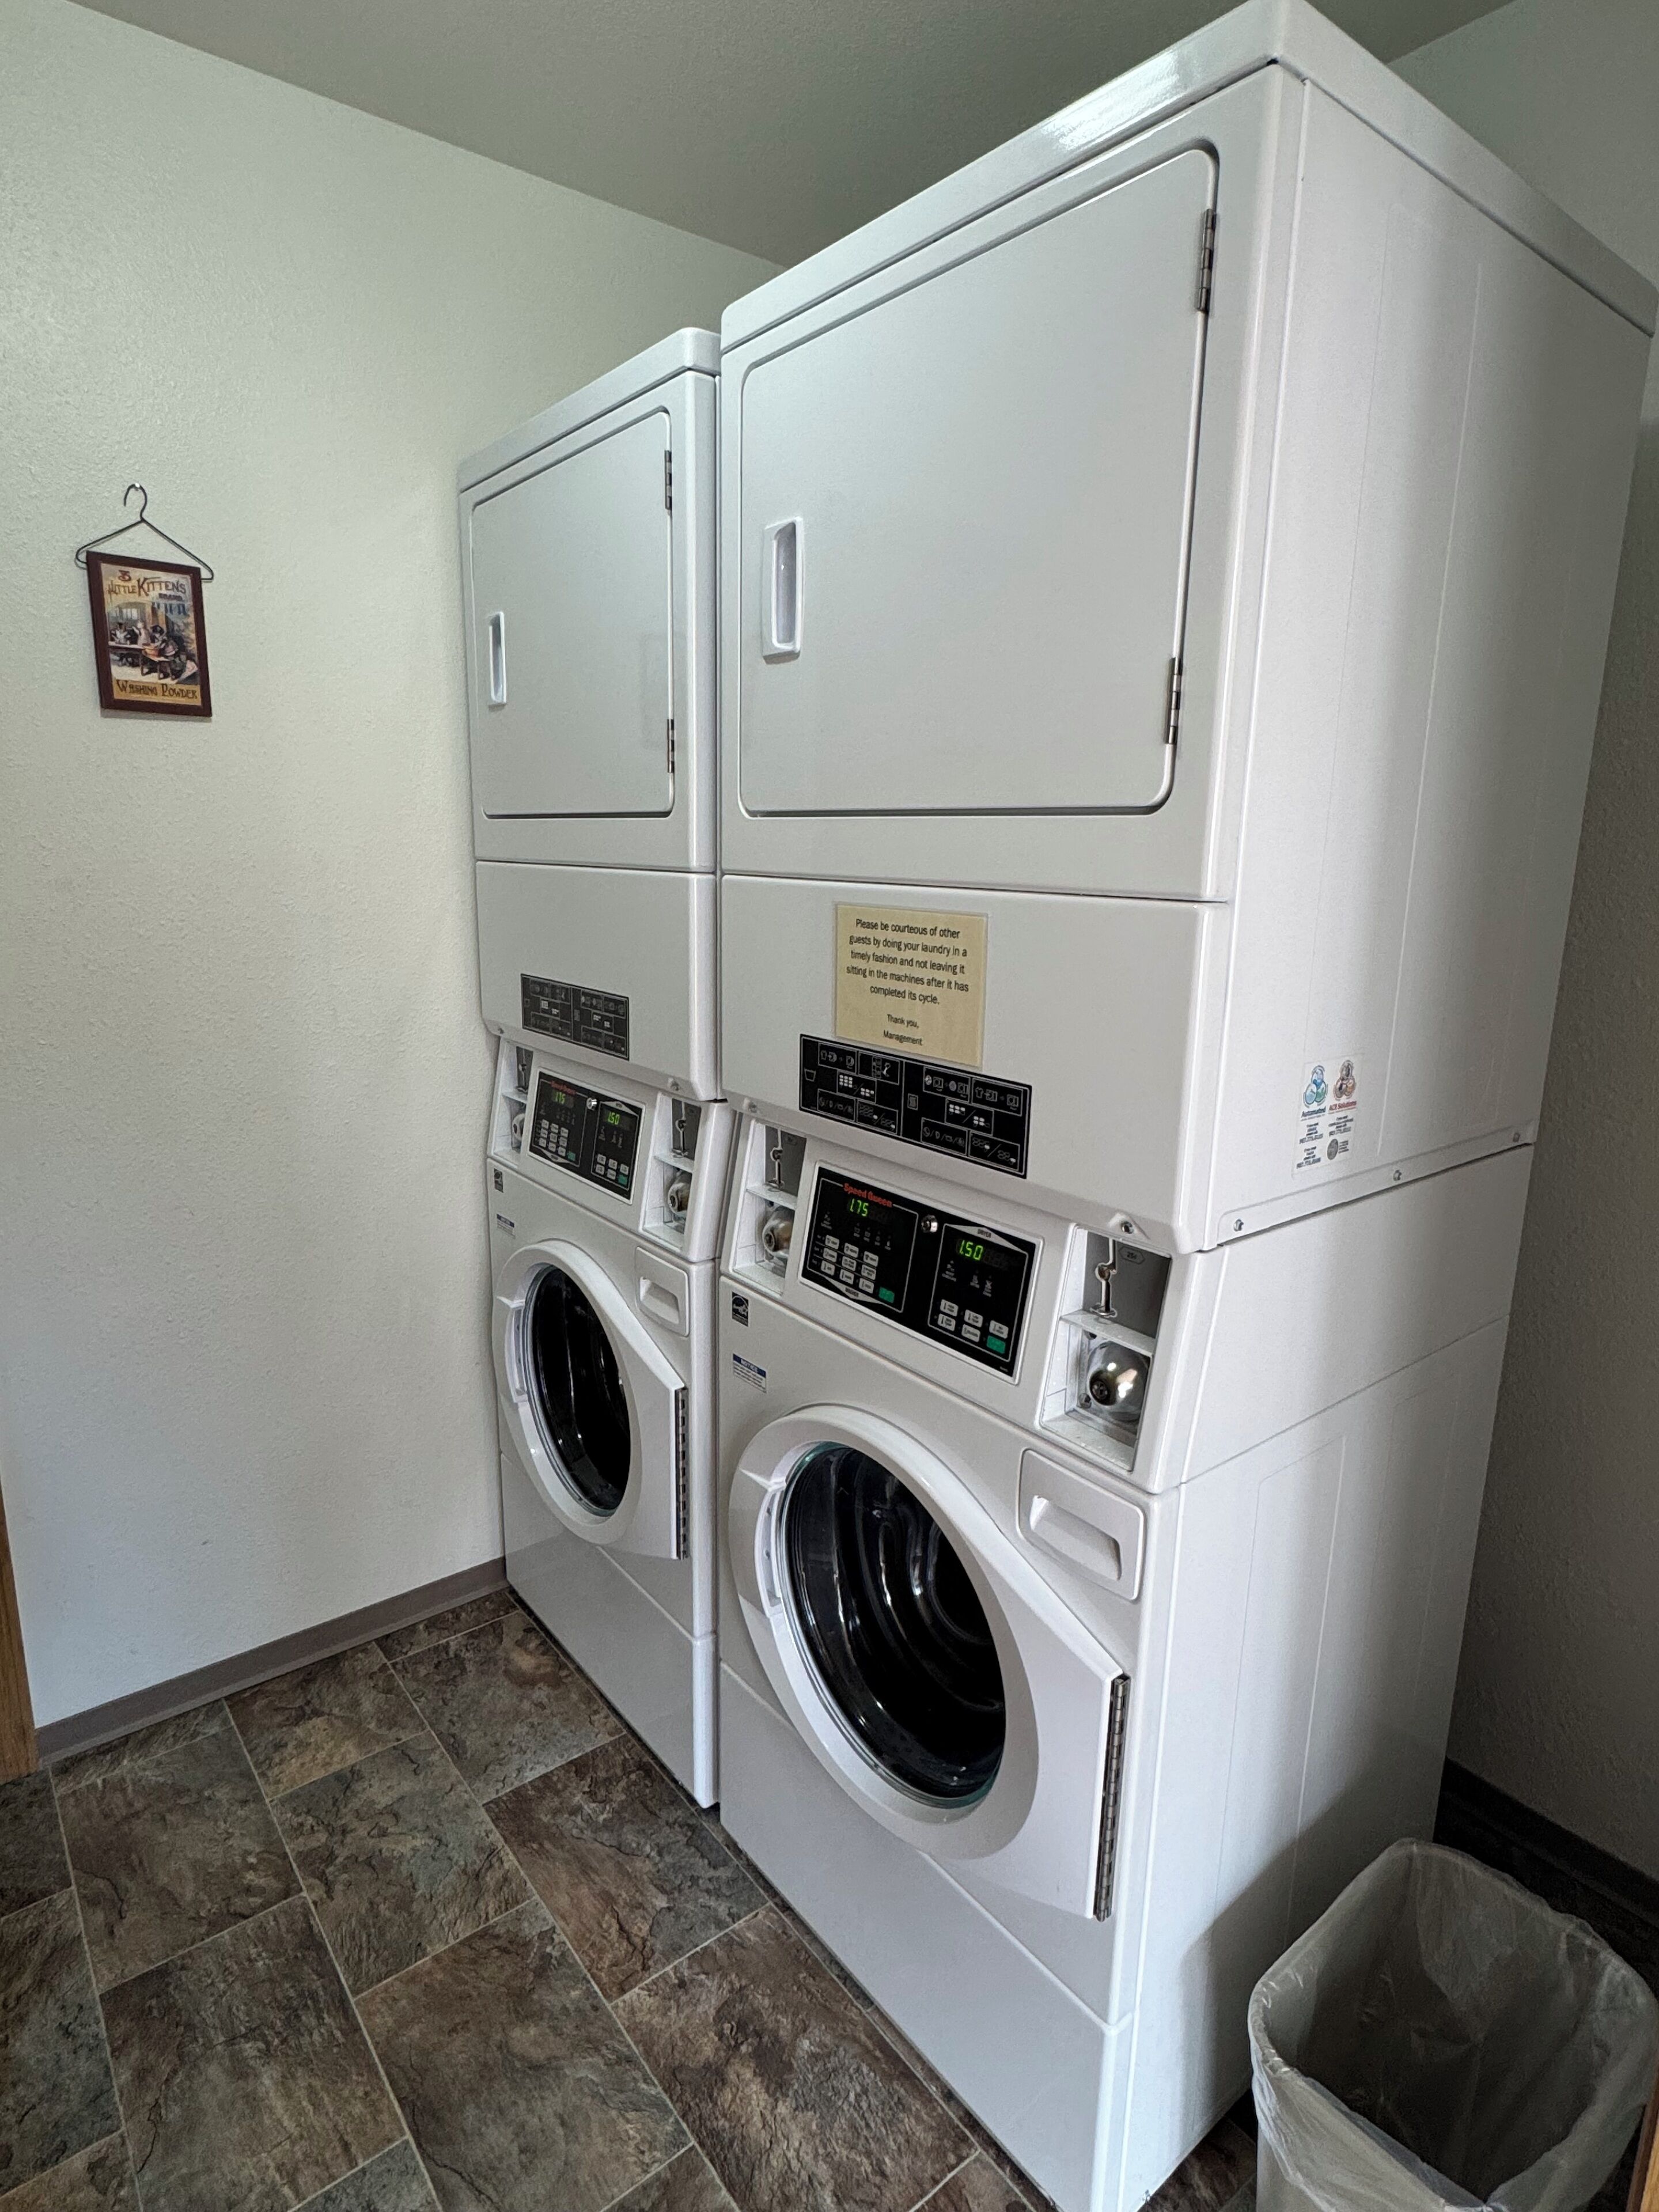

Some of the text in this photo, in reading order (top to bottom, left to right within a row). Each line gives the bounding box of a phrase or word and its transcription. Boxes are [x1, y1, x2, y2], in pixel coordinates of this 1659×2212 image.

[856, 918, 960, 939] Please be courteous of other
[849, 934, 871, 945] guests
[873, 937, 881, 948] by
[882, 938, 902, 950] doing
[903, 942, 920, 952] your
[922, 942, 950, 957] laundry
[952, 946, 960, 957] in
[851, 950, 965, 975] timely fashion and not leaving it
[846, 965, 969, 992] sitting in the machines after it has
[870, 985, 940, 1005] completed its cycle.
[887, 1014, 905, 1025] Thank
[883, 1030, 923, 1046] Management
[843, 1183, 892, 1208] Speed Queen
